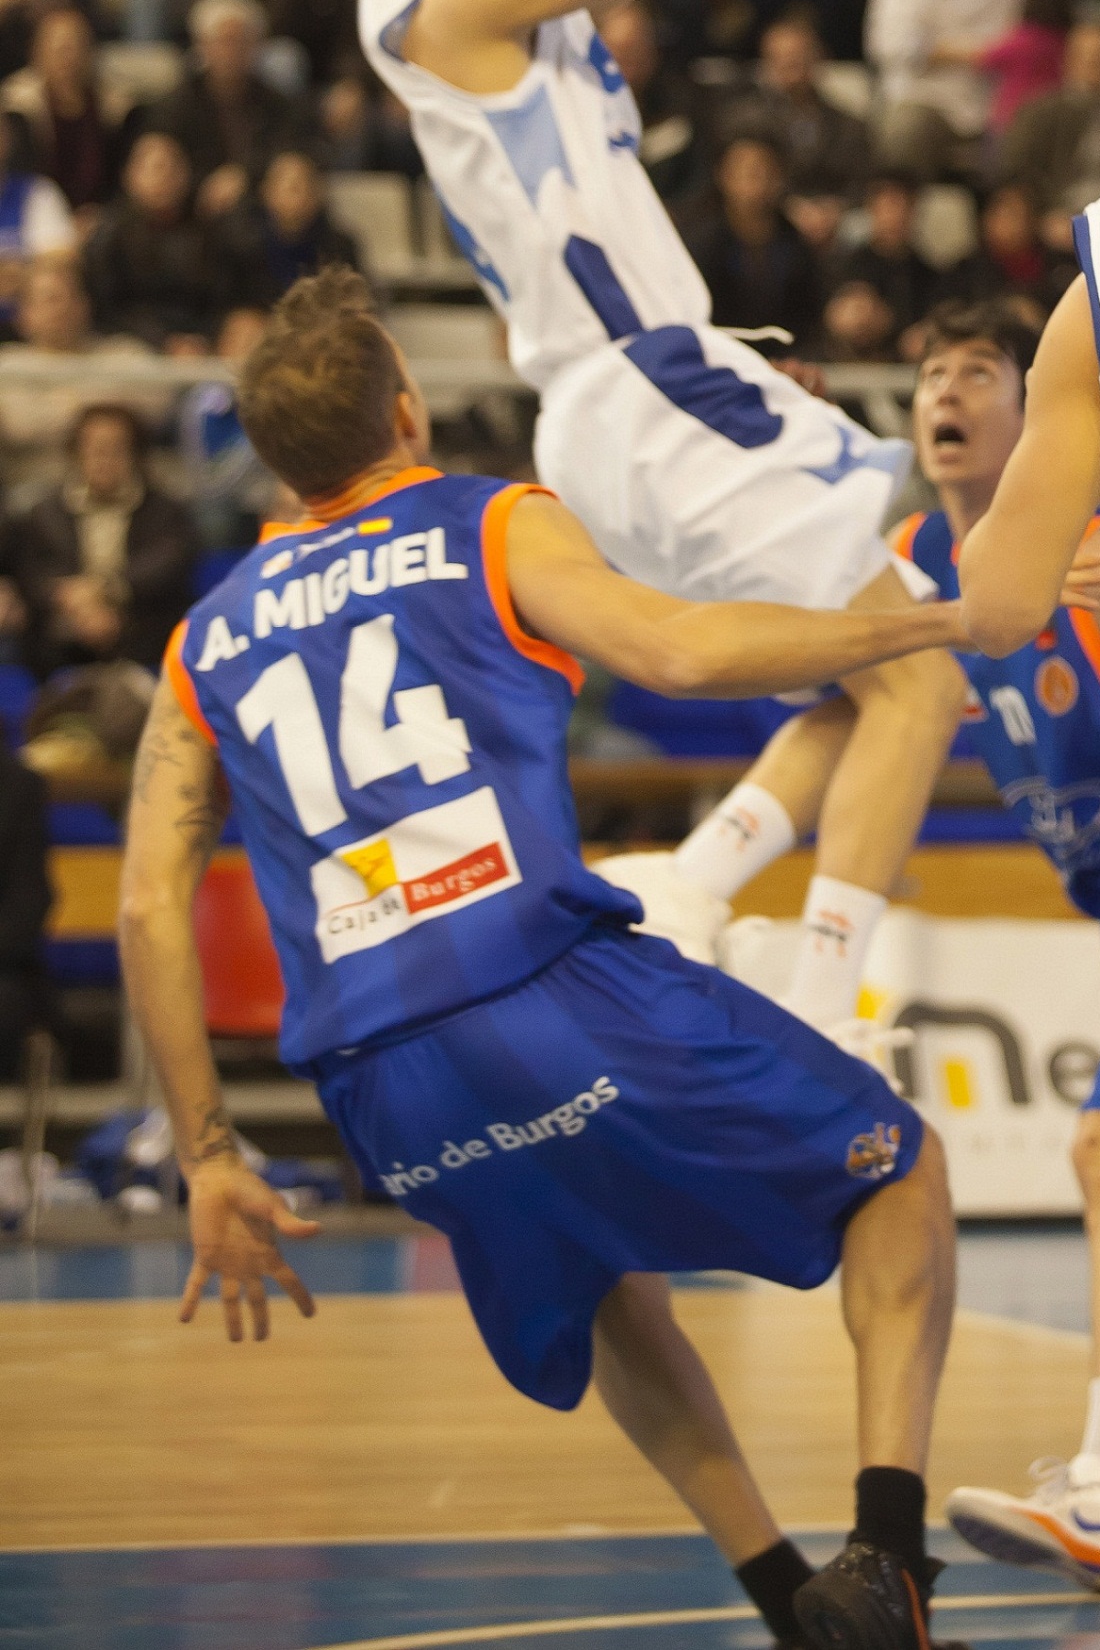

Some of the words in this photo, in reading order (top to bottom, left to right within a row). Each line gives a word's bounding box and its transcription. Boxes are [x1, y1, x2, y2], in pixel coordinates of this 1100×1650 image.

[194, 615, 250, 672] A.
[253, 526, 469, 640] MIGUEL
[235, 612, 474, 838] 14
[327, 909, 379, 936] Caja
[410, 857, 498, 902] Burgos
[439, 1139, 493, 1169] de
[484, 1075, 620, 1152] Burgos
